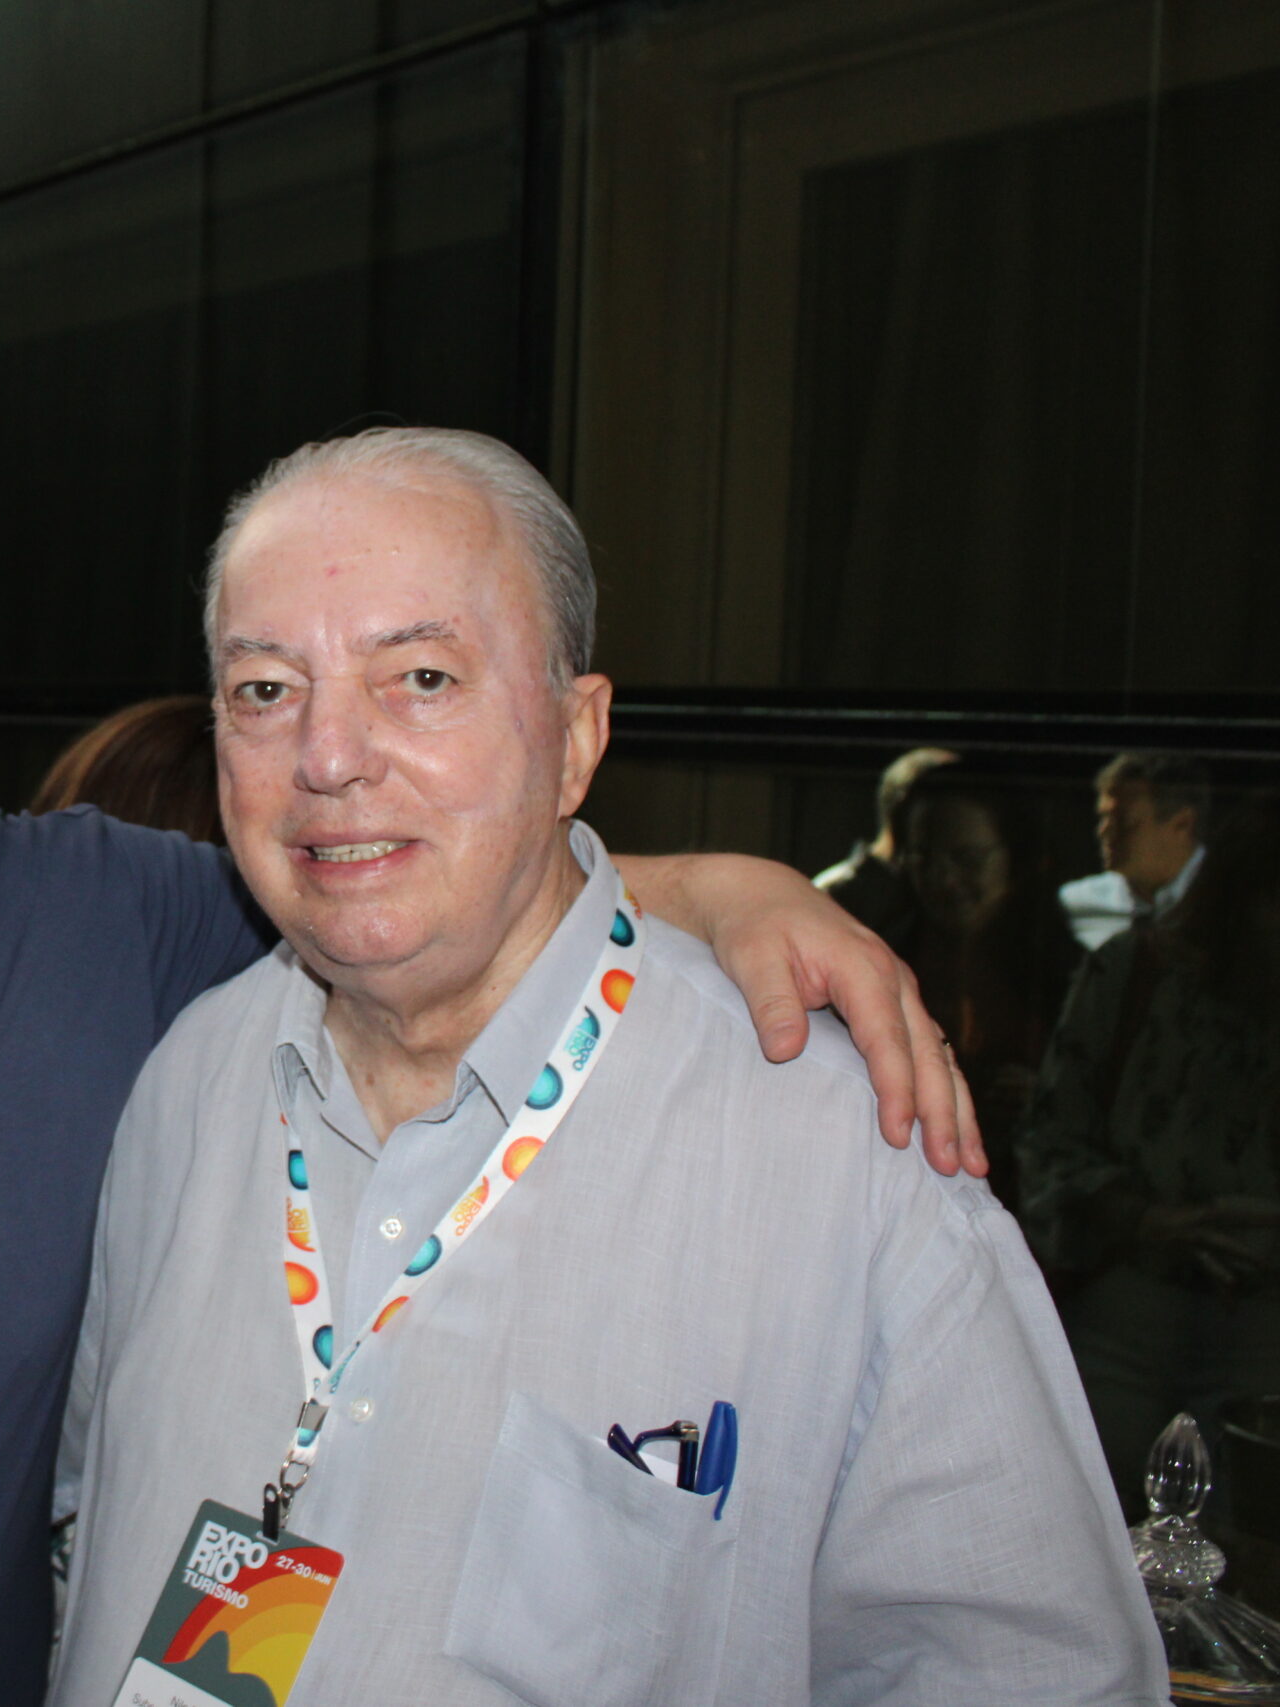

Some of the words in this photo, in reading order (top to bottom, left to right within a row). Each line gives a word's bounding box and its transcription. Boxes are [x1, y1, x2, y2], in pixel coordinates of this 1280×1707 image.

[199, 1520, 269, 1569] EXPO
[186, 1545, 240, 1584] RIO
[183, 1569, 249, 1608] TURISMO
